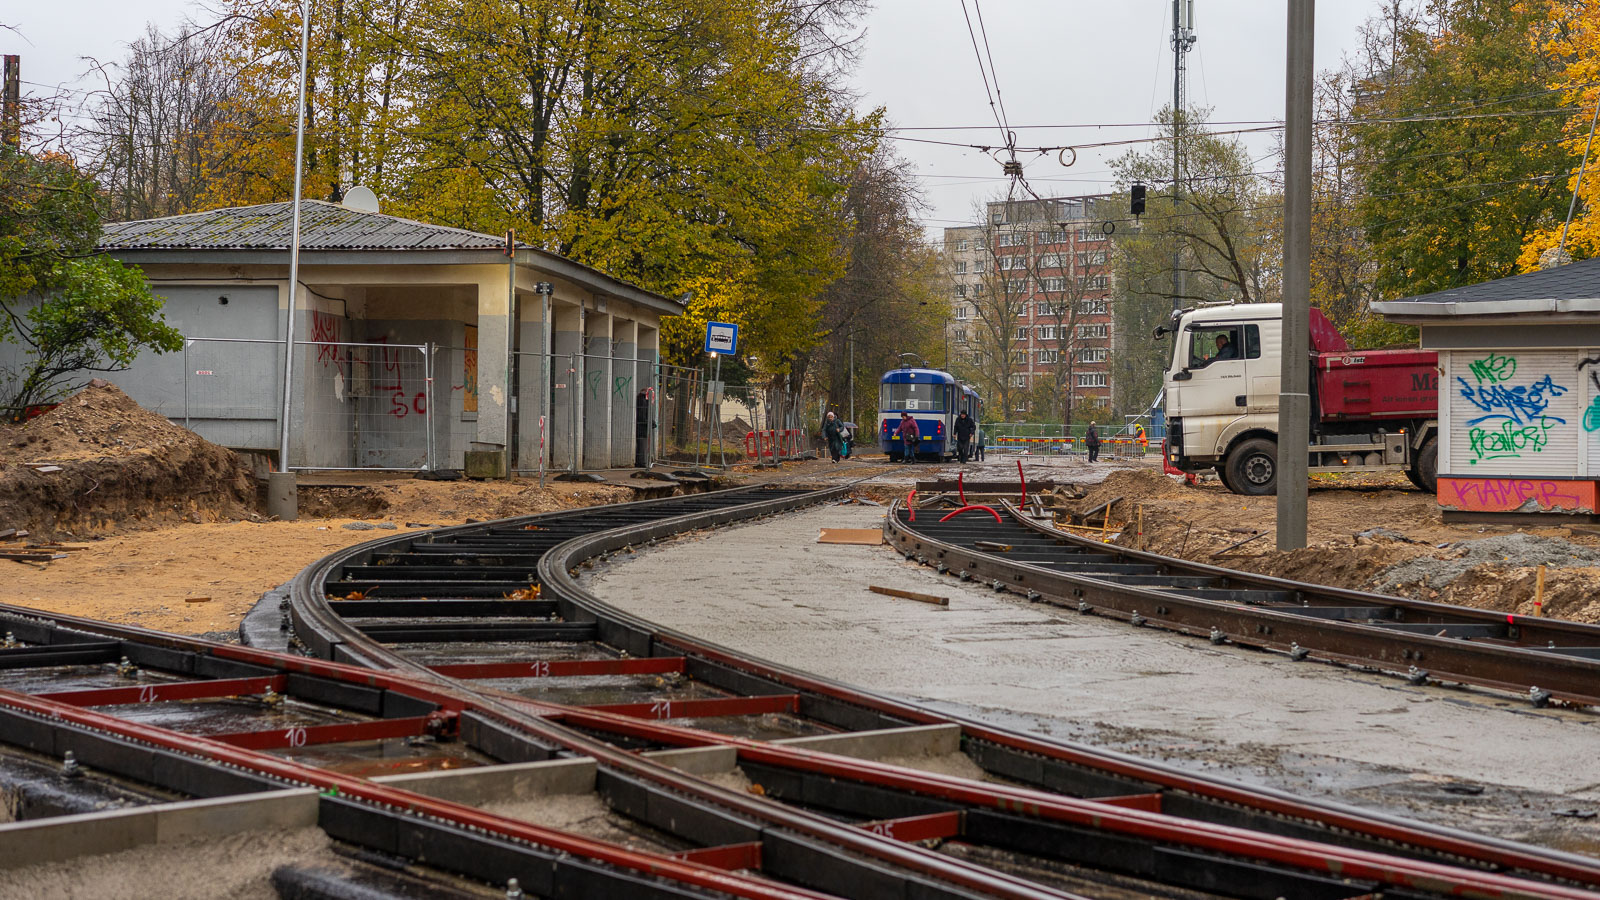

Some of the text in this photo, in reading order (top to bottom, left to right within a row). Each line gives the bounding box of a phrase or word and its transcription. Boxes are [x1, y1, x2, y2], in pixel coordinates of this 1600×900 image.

[909, 400, 915, 408] 5
[530, 660, 549, 677] 13
[650, 701, 670, 719] 11
[285, 727, 306, 747] 10
